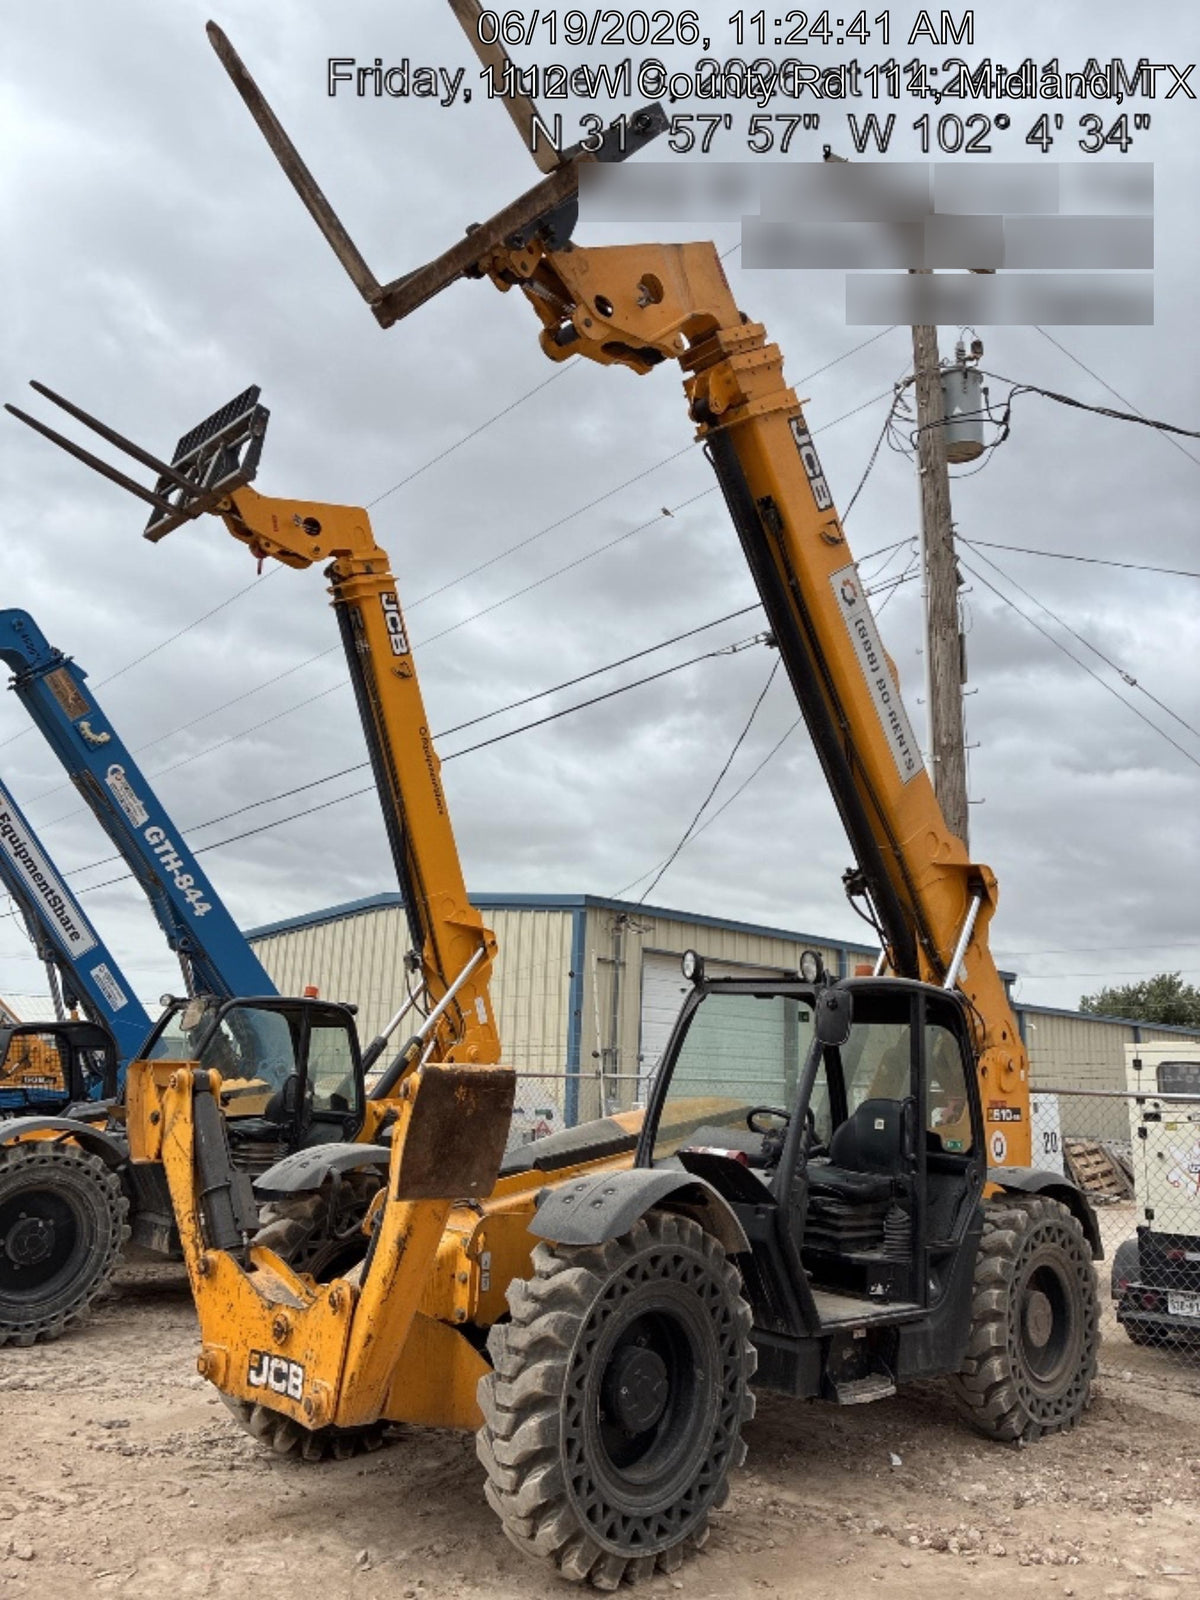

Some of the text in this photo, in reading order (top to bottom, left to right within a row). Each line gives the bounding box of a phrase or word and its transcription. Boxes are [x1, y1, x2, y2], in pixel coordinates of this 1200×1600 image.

[788, 415, 834, 512] JCB
[379, 591, 412, 657] JCB
[854, 617, 882, 674] (888)
[0, 811, 82, 943] EquipmentShare
[144, 825, 212, 918] GTH-844
[248, 1352, 305, 1402] JCB
